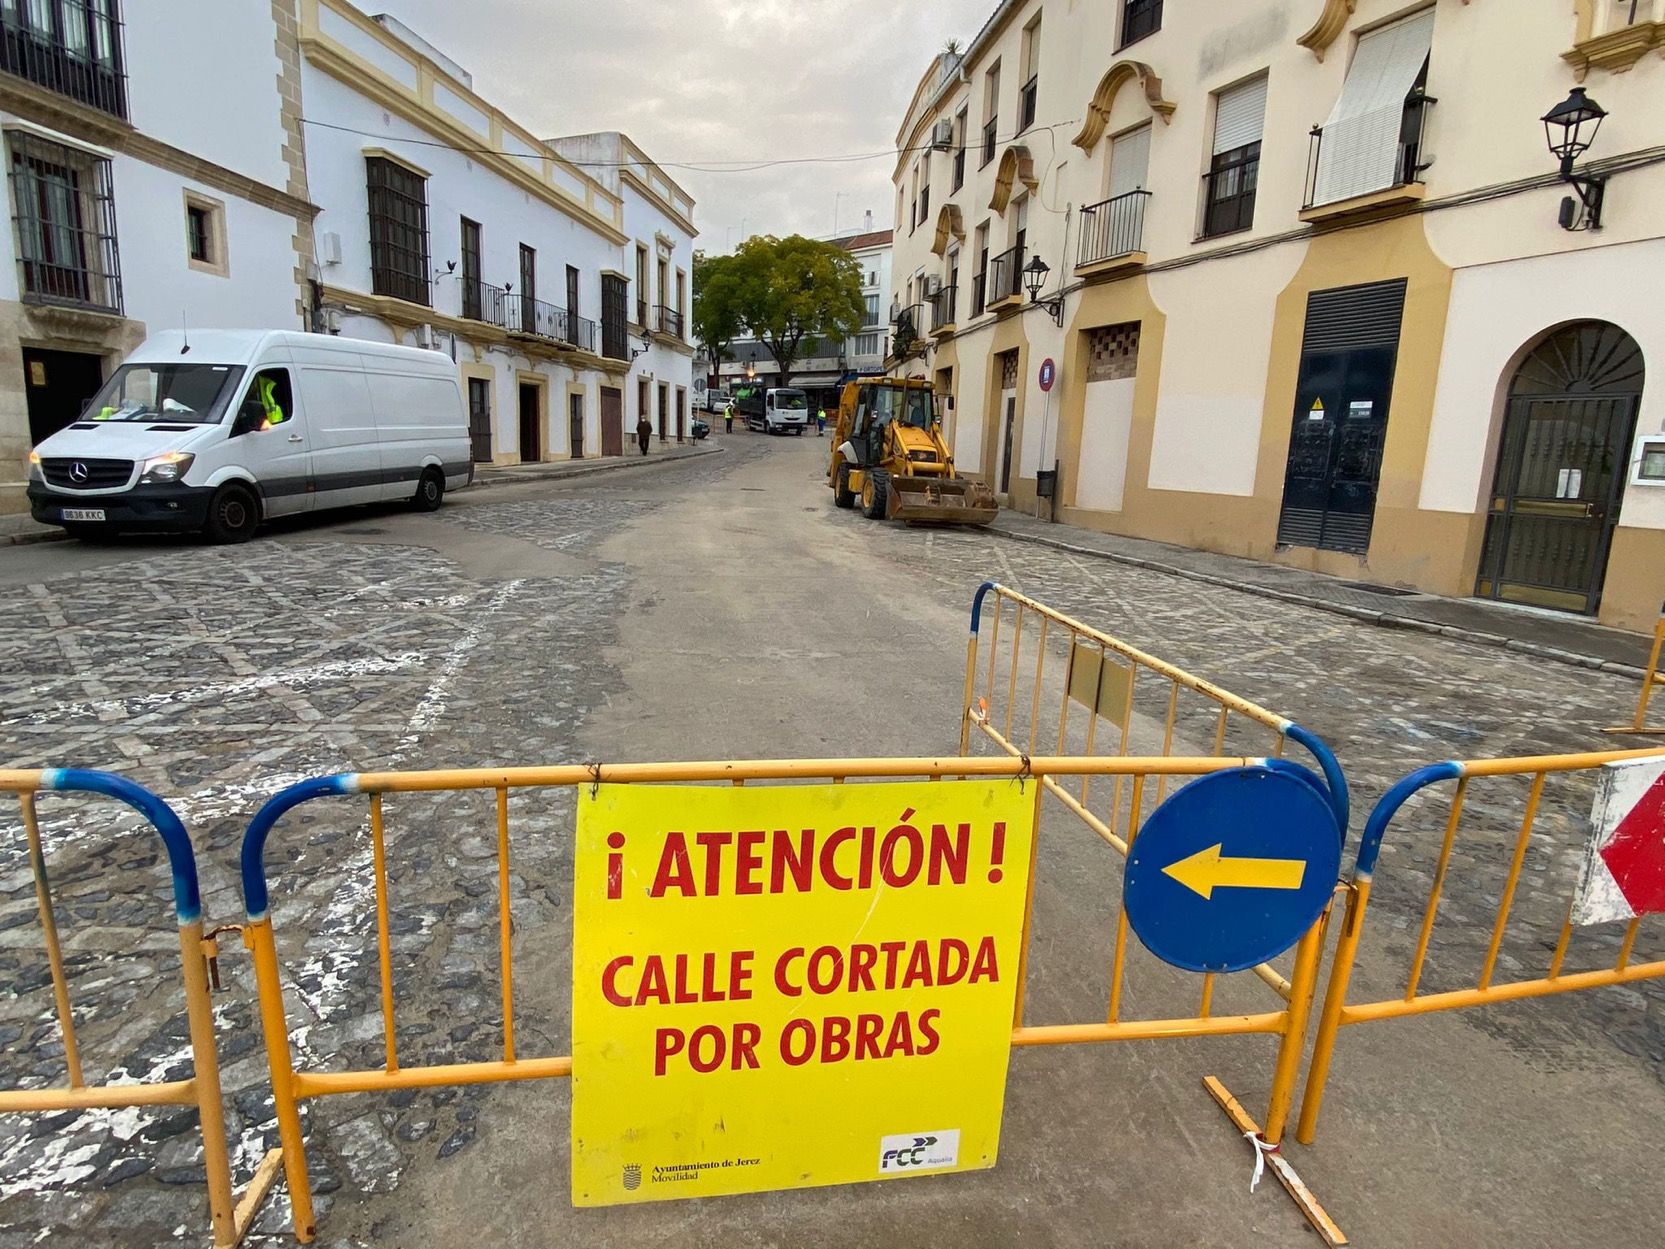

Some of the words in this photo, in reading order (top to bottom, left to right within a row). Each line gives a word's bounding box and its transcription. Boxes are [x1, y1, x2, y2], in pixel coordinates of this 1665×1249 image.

[650, 807, 971, 898] ATENCIÓN
[601, 950, 754, 1007] CALLE
[774, 936, 999, 997] CORTADA
[654, 1023, 761, 1076] POR
[779, 1008, 941, 1066] OBRAS
[651, 1172, 698, 1183] Movilidad
[653, 1161, 720, 1175] Ayuntamiento
[721, 1159, 733, 1167] de
[735, 1158, 761, 1166] Jerez
[882, 1147, 926, 1168] FCC
